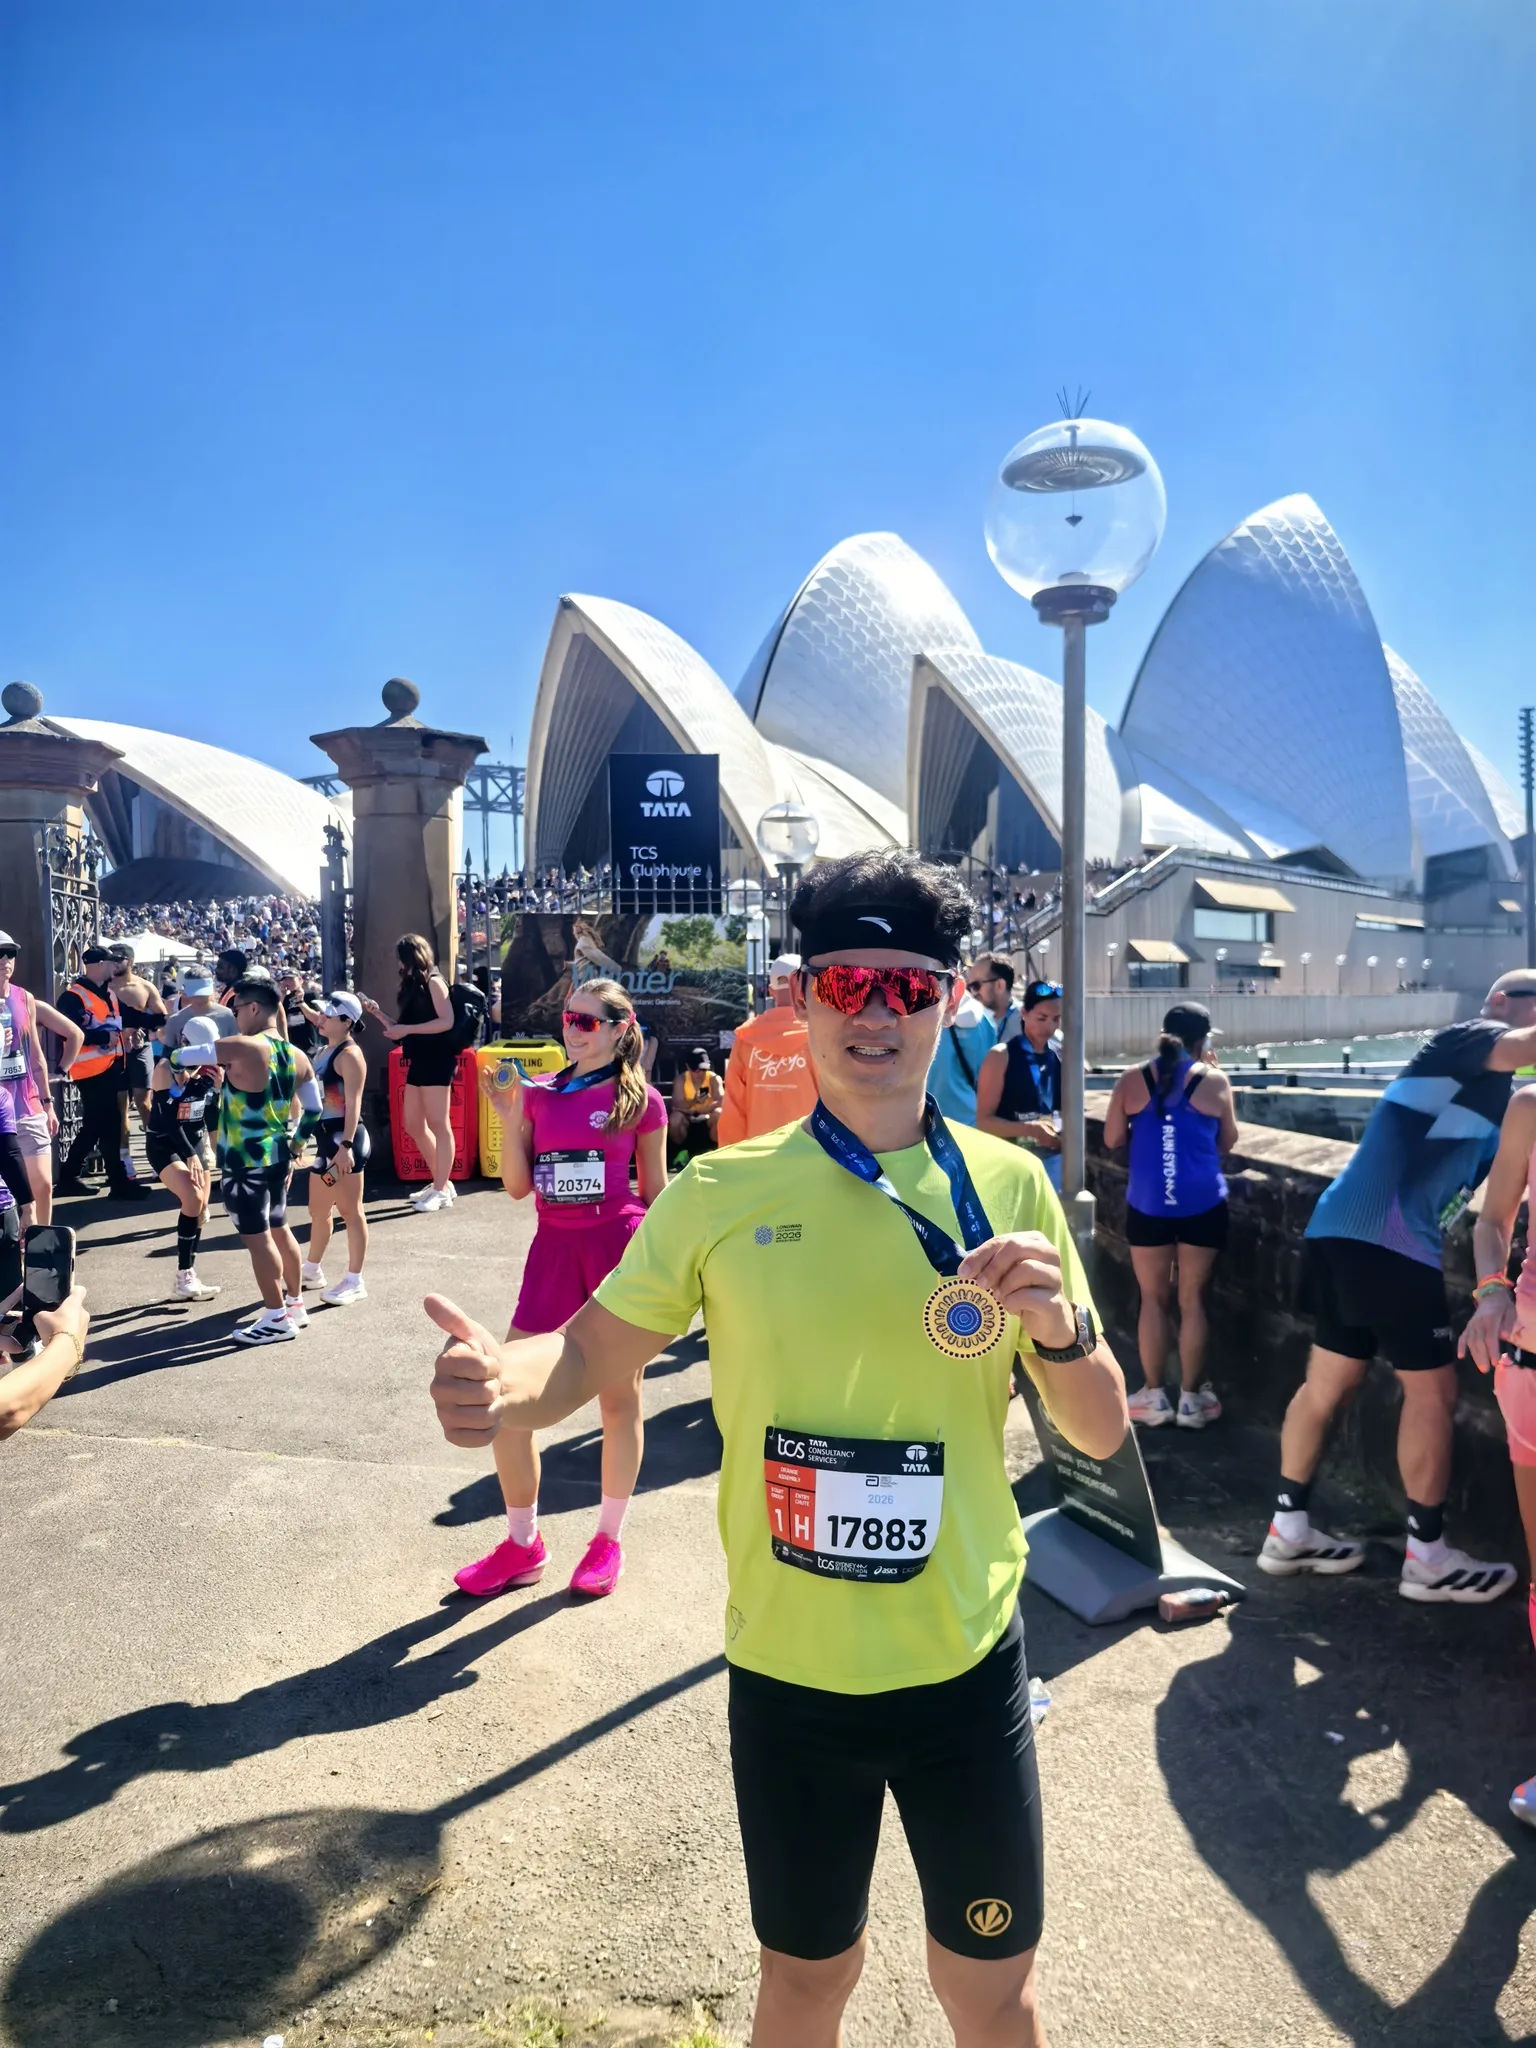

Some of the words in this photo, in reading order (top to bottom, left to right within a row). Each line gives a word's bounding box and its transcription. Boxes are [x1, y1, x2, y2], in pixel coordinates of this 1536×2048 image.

[640, 802, 692, 817] TATA
[629, 846, 658, 860] TCS
[630, 863, 702, 877] Clubhoue
[572, 963, 683, 994] Wnter
[546, 1182, 554, 1193] A
[557, 1178, 602, 1193] 20374
[776, 1232, 802, 1240] 2026
[778, 1433, 805, 1459] tcs
[808, 1439, 828, 1448] TATA
[901, 1463, 930, 1473] TATA
[808, 1447, 855, 1458] CONSULTANCY
[808, 1455, 837, 1464] SERVICES
[868, 1494, 894, 1504] 2026
[774, 1508, 783, 1533] 1
[794, 1514, 810, 1540] H
[827, 1515, 927, 1551] 17883
[817, 1555, 834, 1571] tcs
